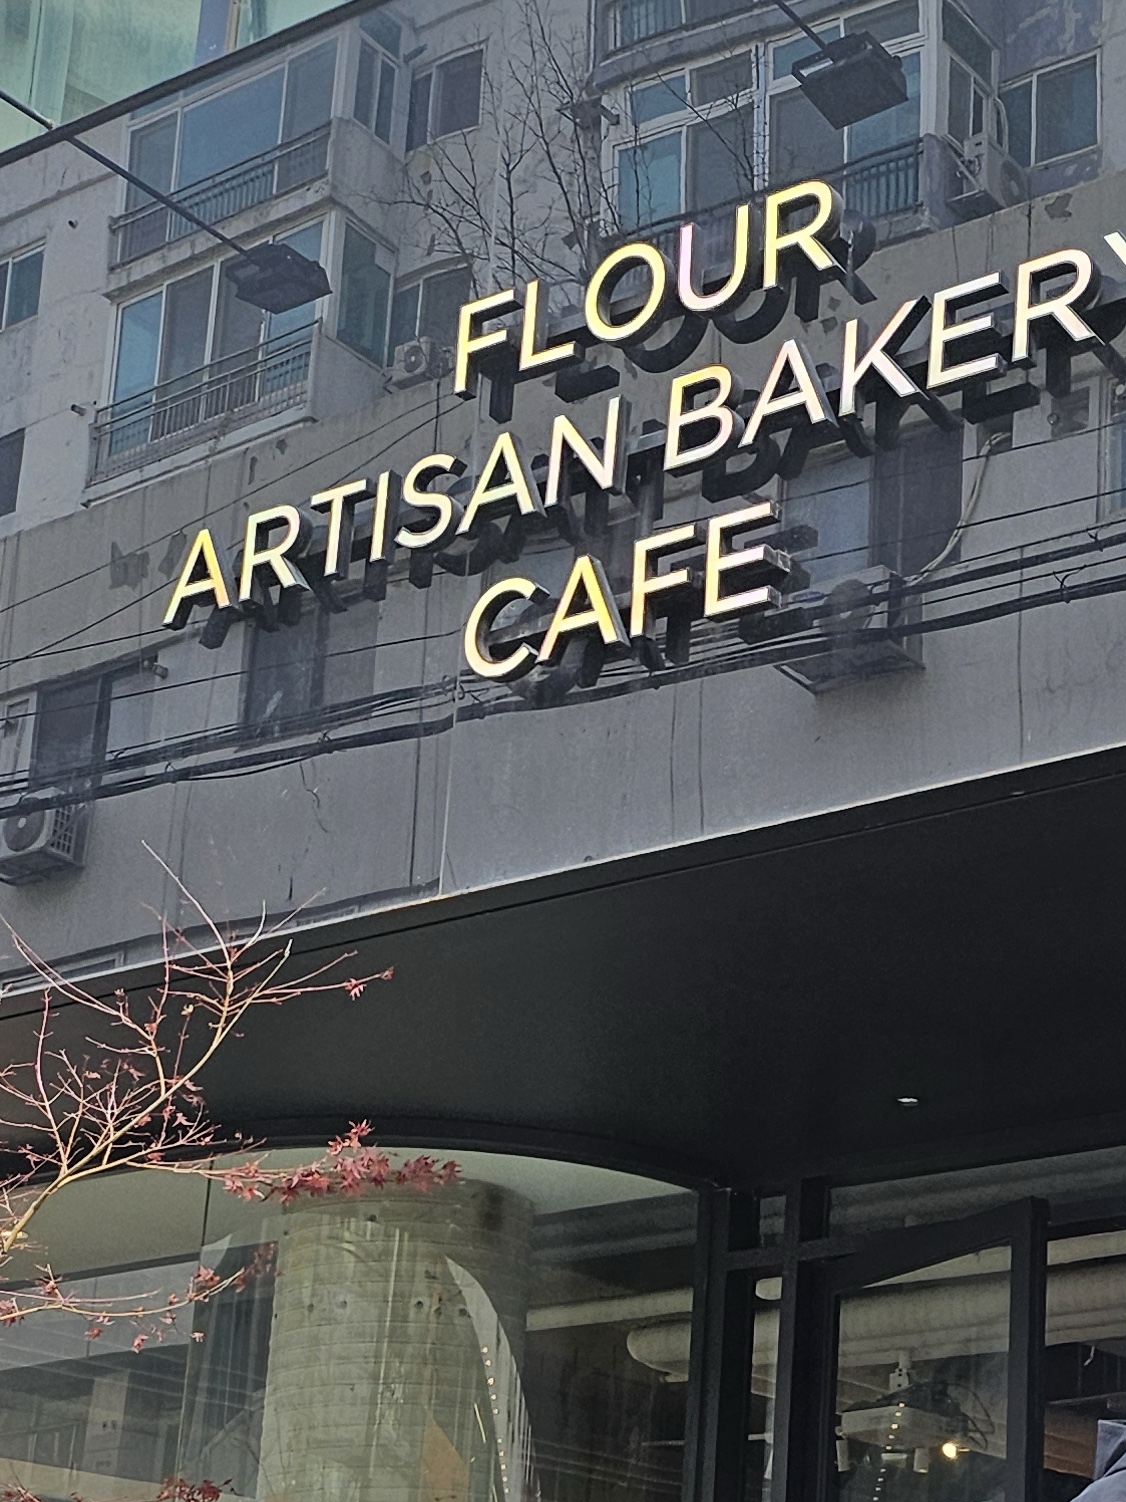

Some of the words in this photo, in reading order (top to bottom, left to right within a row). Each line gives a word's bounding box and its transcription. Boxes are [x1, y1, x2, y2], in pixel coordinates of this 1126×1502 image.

[454, 179, 840, 397] FLOUR
[163, 397, 623, 628] ARTISAN
[464, 502, 780, 680] CAFE
